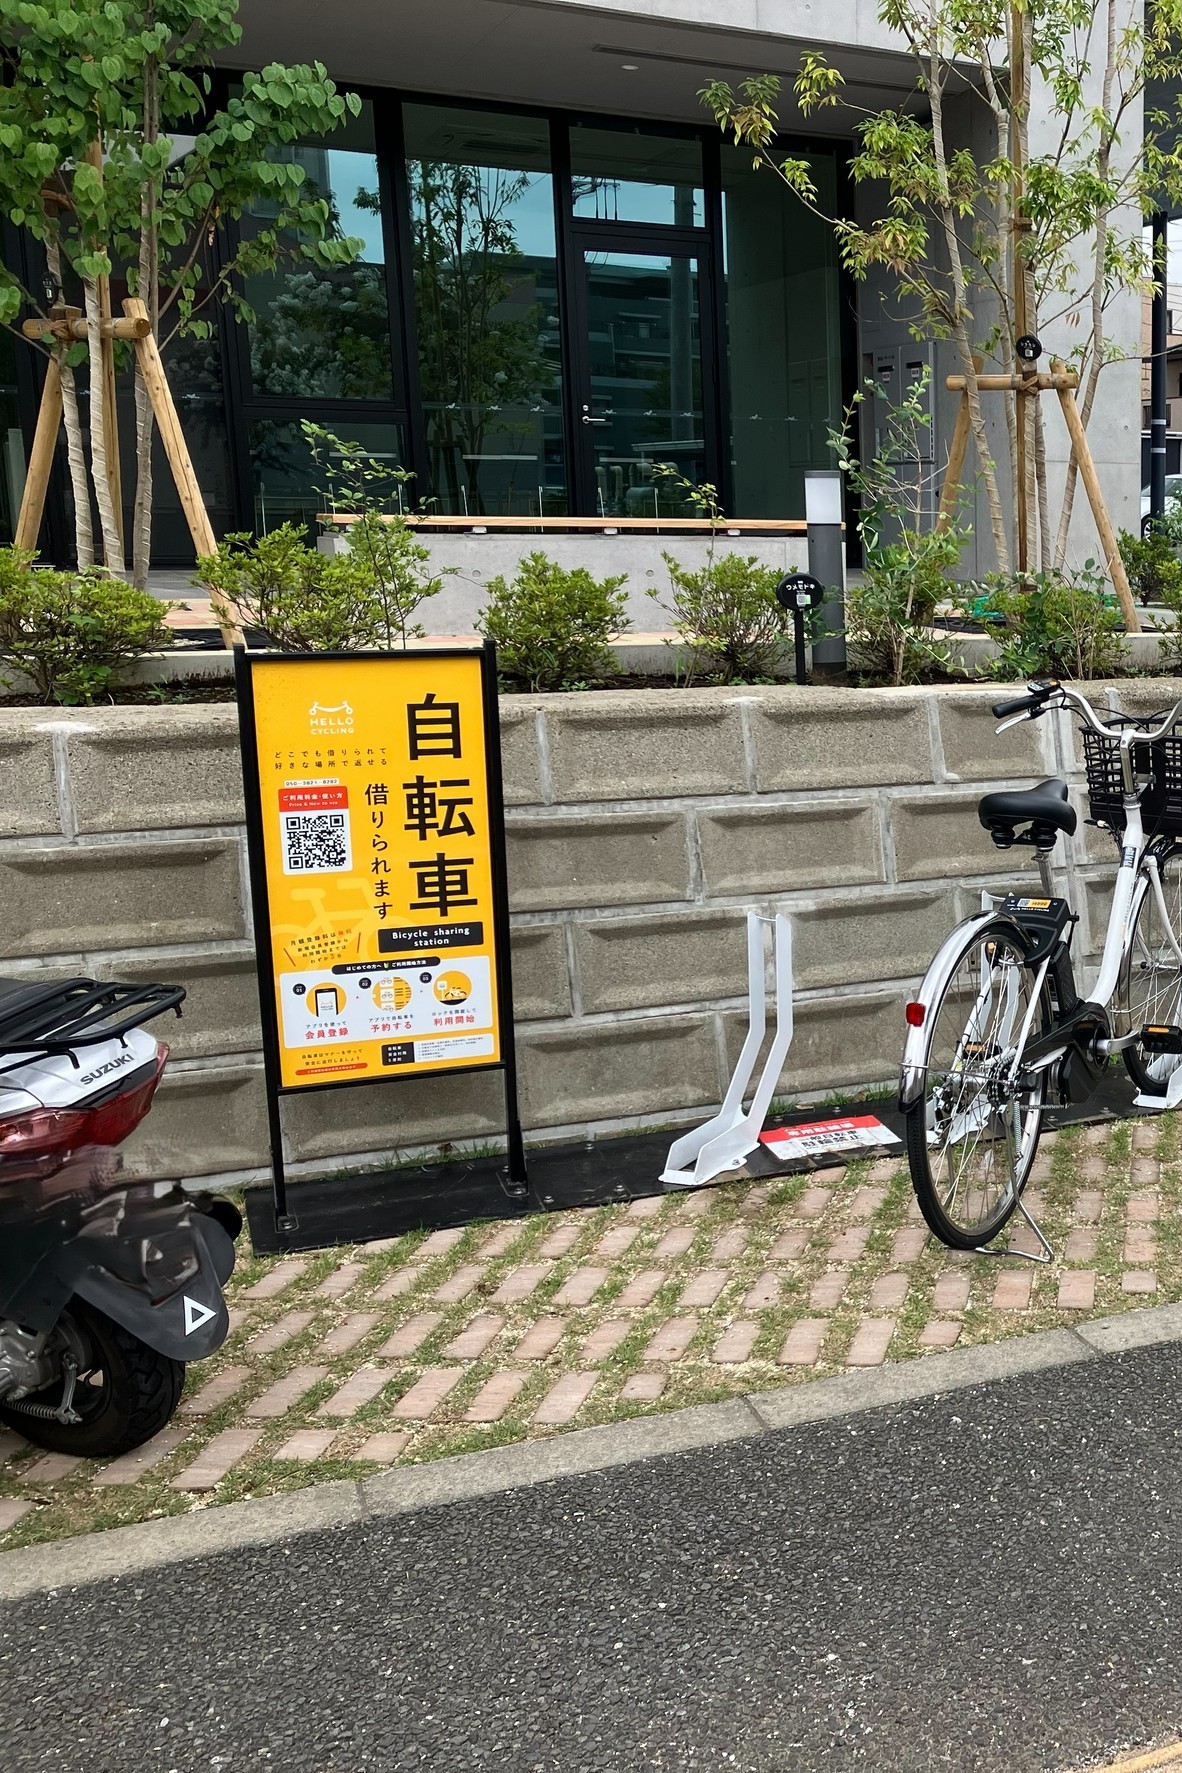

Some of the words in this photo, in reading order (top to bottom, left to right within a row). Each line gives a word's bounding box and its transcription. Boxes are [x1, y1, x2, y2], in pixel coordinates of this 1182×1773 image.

[310, 717, 354, 727] HELLO
[310, 728, 355, 736] CYCLING
[274, 747, 387, 759] どこでも借りられて
[274, 758, 388, 770] 好きな場所で返せる
[403, 692, 479, 918] 自転車
[364, 783, 393, 920] 借りられます
[392, 929, 429, 940] Bicycle
[434, 927, 470, 937] sharing
[414, 937, 450, 947] station
[433, 1014, 476, 1026] 利用開始
[370, 1021, 412, 1033] 予約する
[305, 1028, 349, 1040] 会員登録
[80, 1053, 135, 1085] SUZUKI
